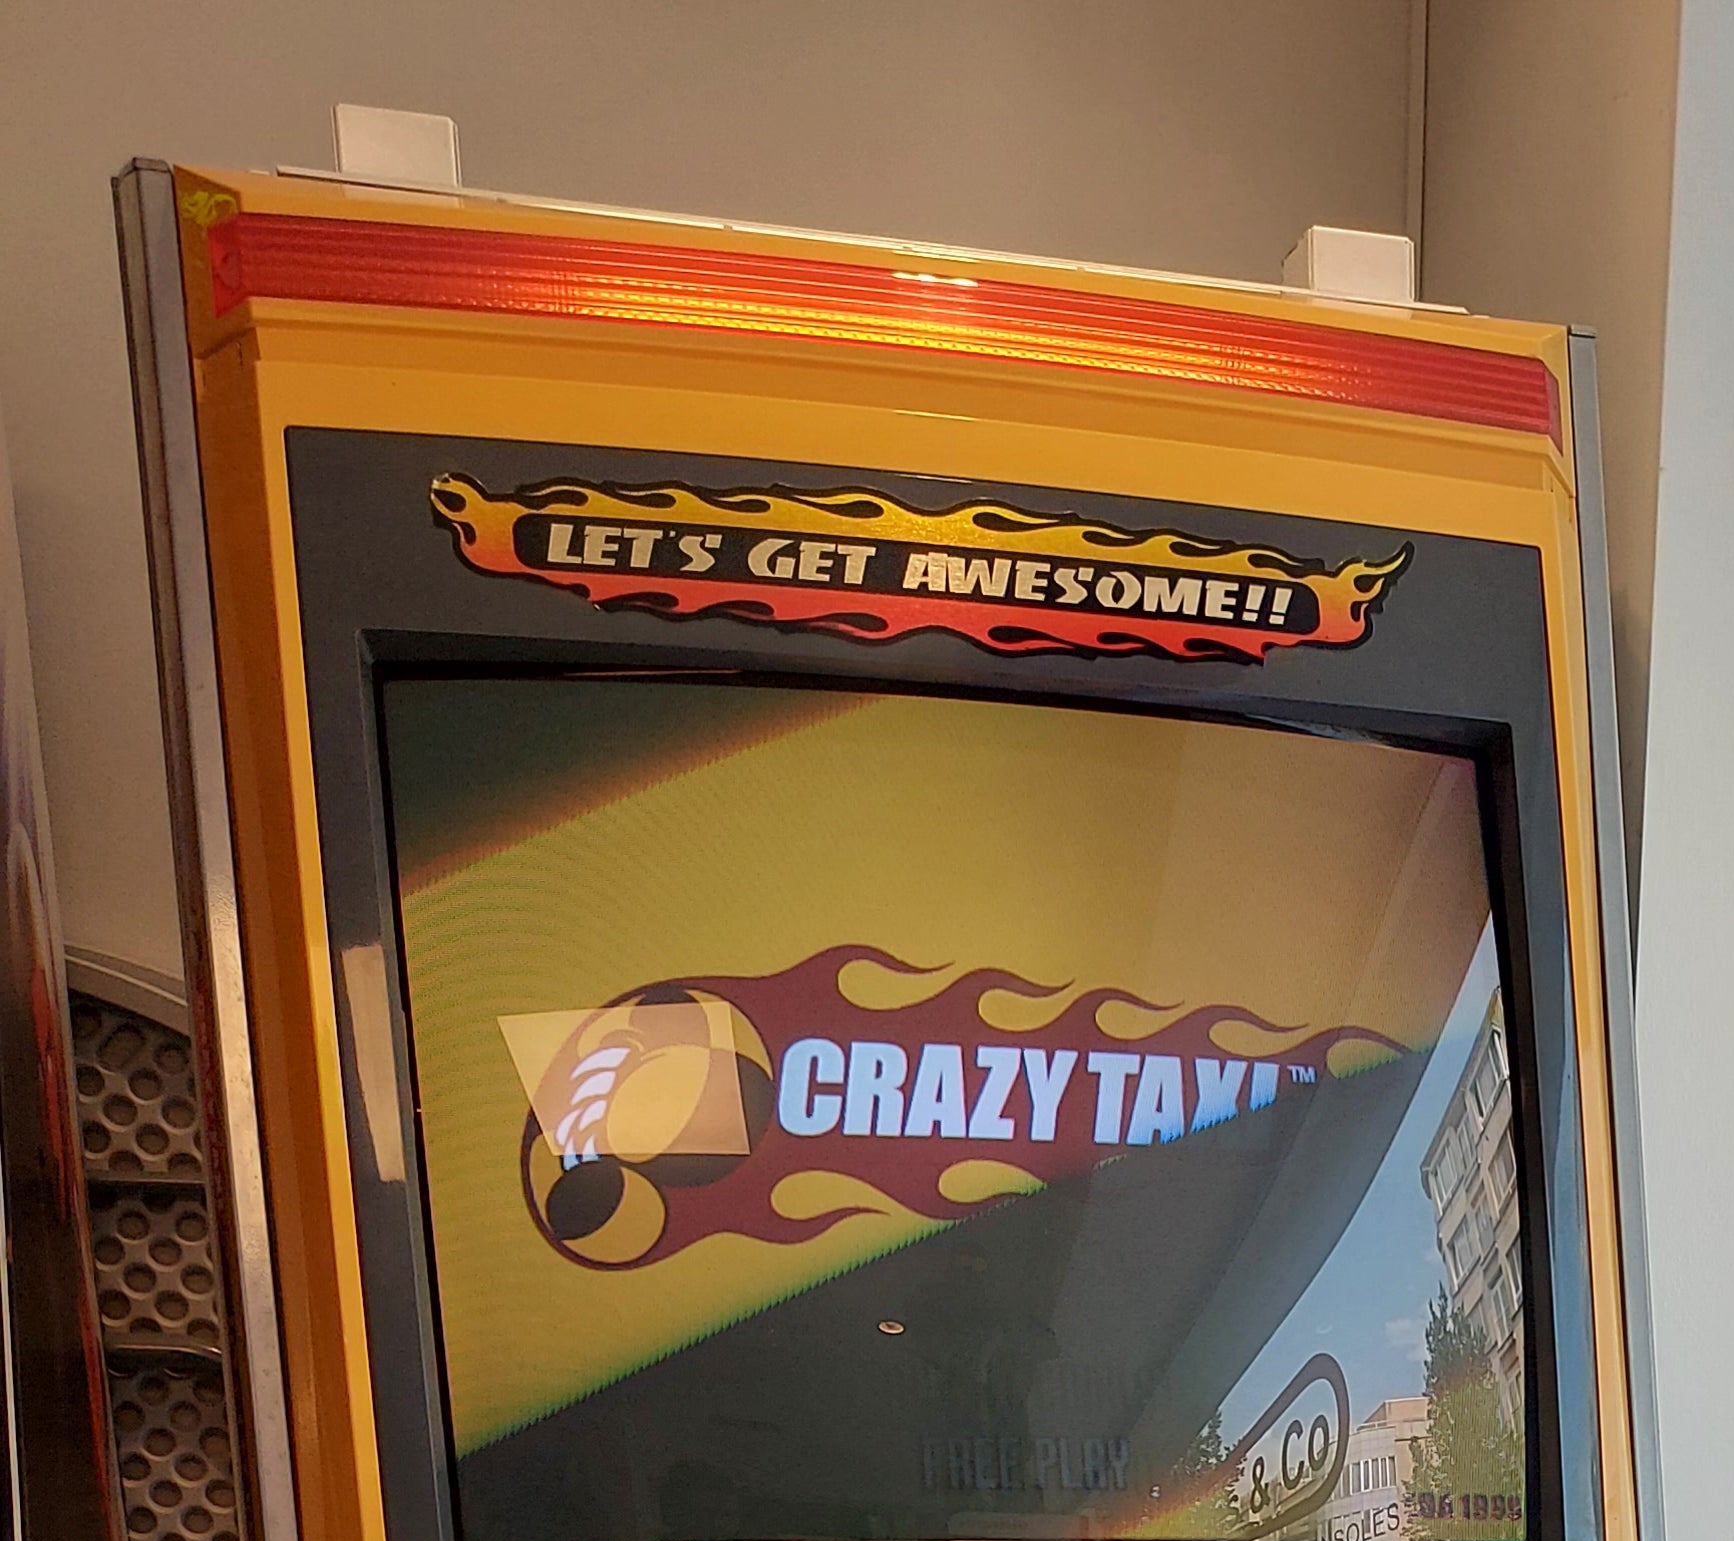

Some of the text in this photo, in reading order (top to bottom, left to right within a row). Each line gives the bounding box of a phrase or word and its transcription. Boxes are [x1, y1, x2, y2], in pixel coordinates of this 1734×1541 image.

[545, 521, 1295, 628] LET'S GET AWESOME!!
[777, 1037, 1079, 1142] CRAZY
[1034, 1437, 1130, 1491] PLAY
